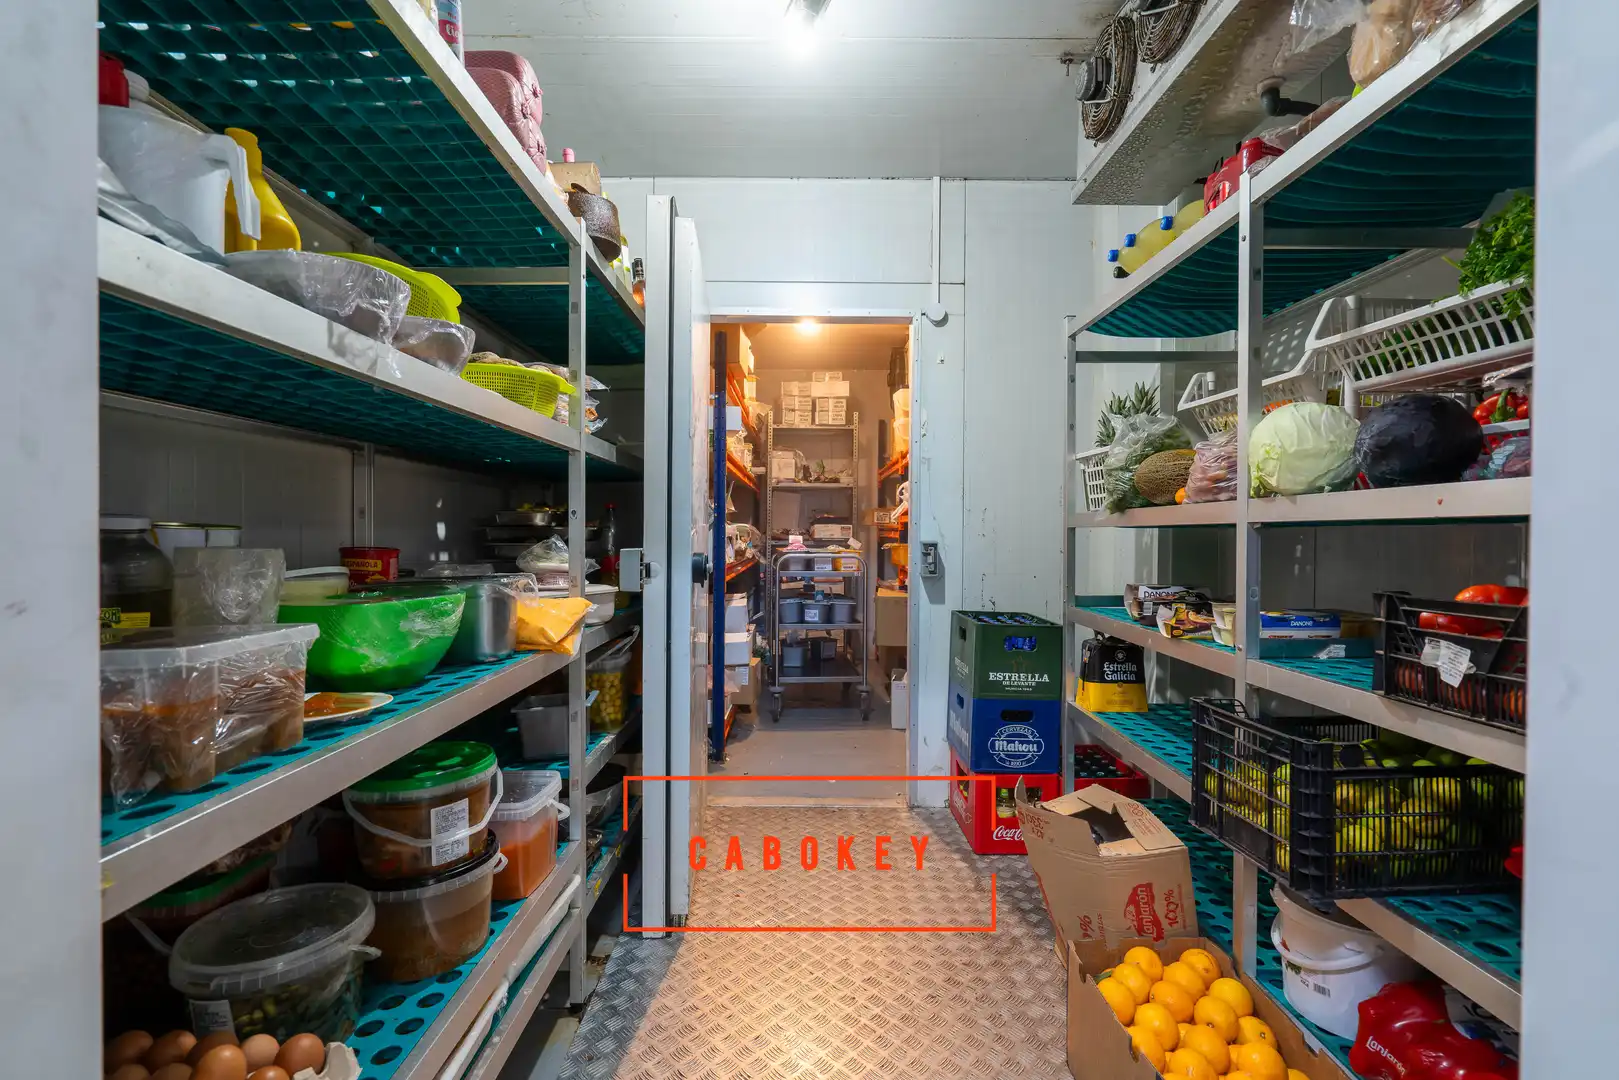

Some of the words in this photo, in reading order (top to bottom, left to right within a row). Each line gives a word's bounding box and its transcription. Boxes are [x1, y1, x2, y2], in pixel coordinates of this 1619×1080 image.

[1103, 662, 1137, 672] Estrella
[988, 672, 1050, 682] ESTRELLA
[1104, 671, 1136, 681] Galicia
[995, 740, 1038, 752] Mahou
